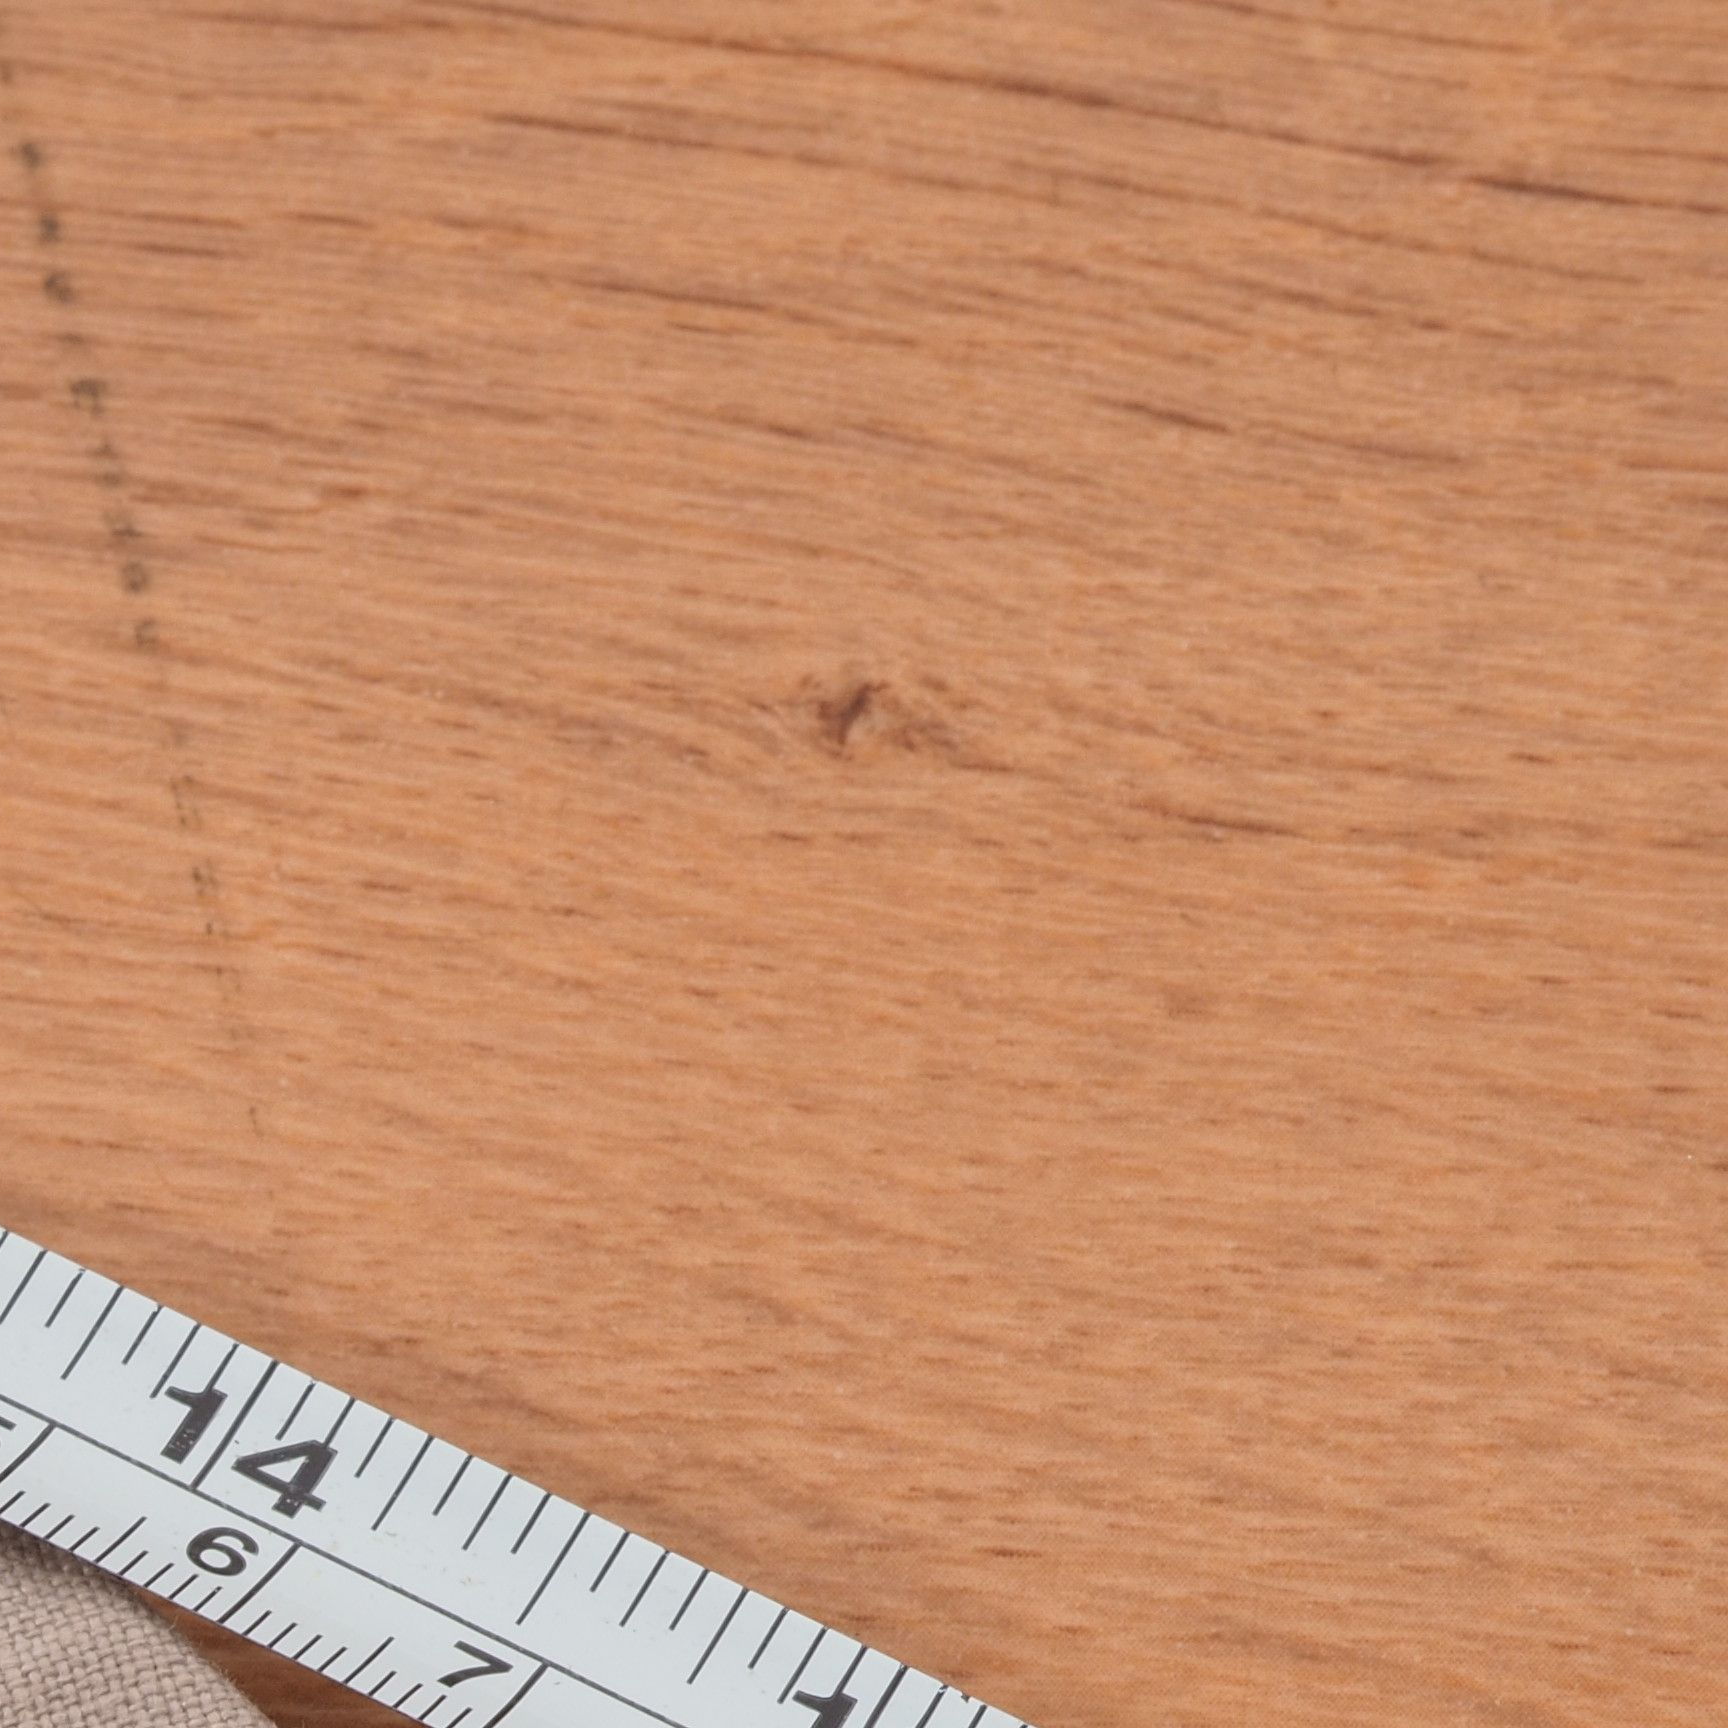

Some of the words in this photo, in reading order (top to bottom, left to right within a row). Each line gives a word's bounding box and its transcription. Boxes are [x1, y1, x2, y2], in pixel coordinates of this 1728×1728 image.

[160, 1385, 338, 1519] 14
[186, 1526, 260, 1577] 6
[436, 1640, 513, 1688] 7
